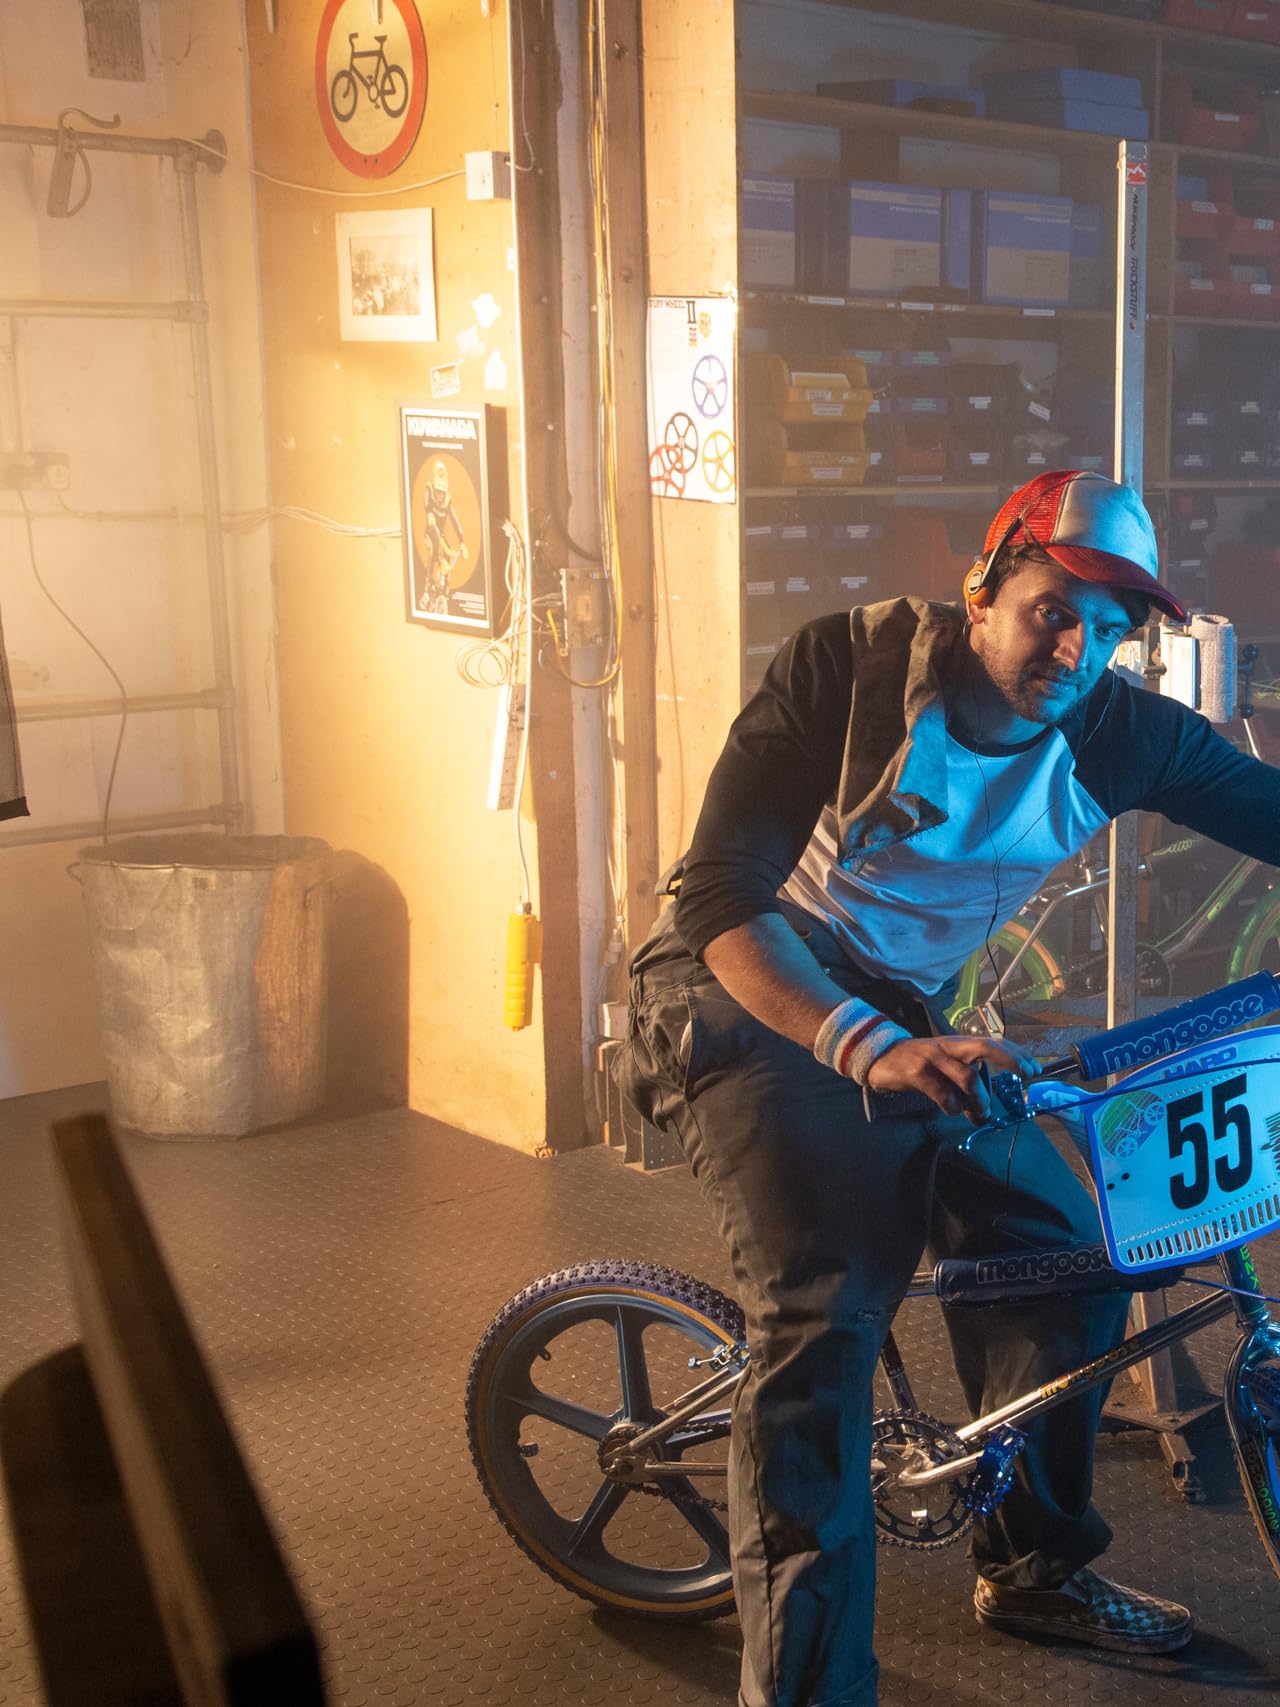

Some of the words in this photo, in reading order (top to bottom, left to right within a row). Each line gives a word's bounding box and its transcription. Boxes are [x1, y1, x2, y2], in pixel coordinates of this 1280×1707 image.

[1103, 994, 1264, 1073] mongoose
[1166, 1073, 1253, 1210] 55
[976, 1248, 1115, 1284] mongoos
